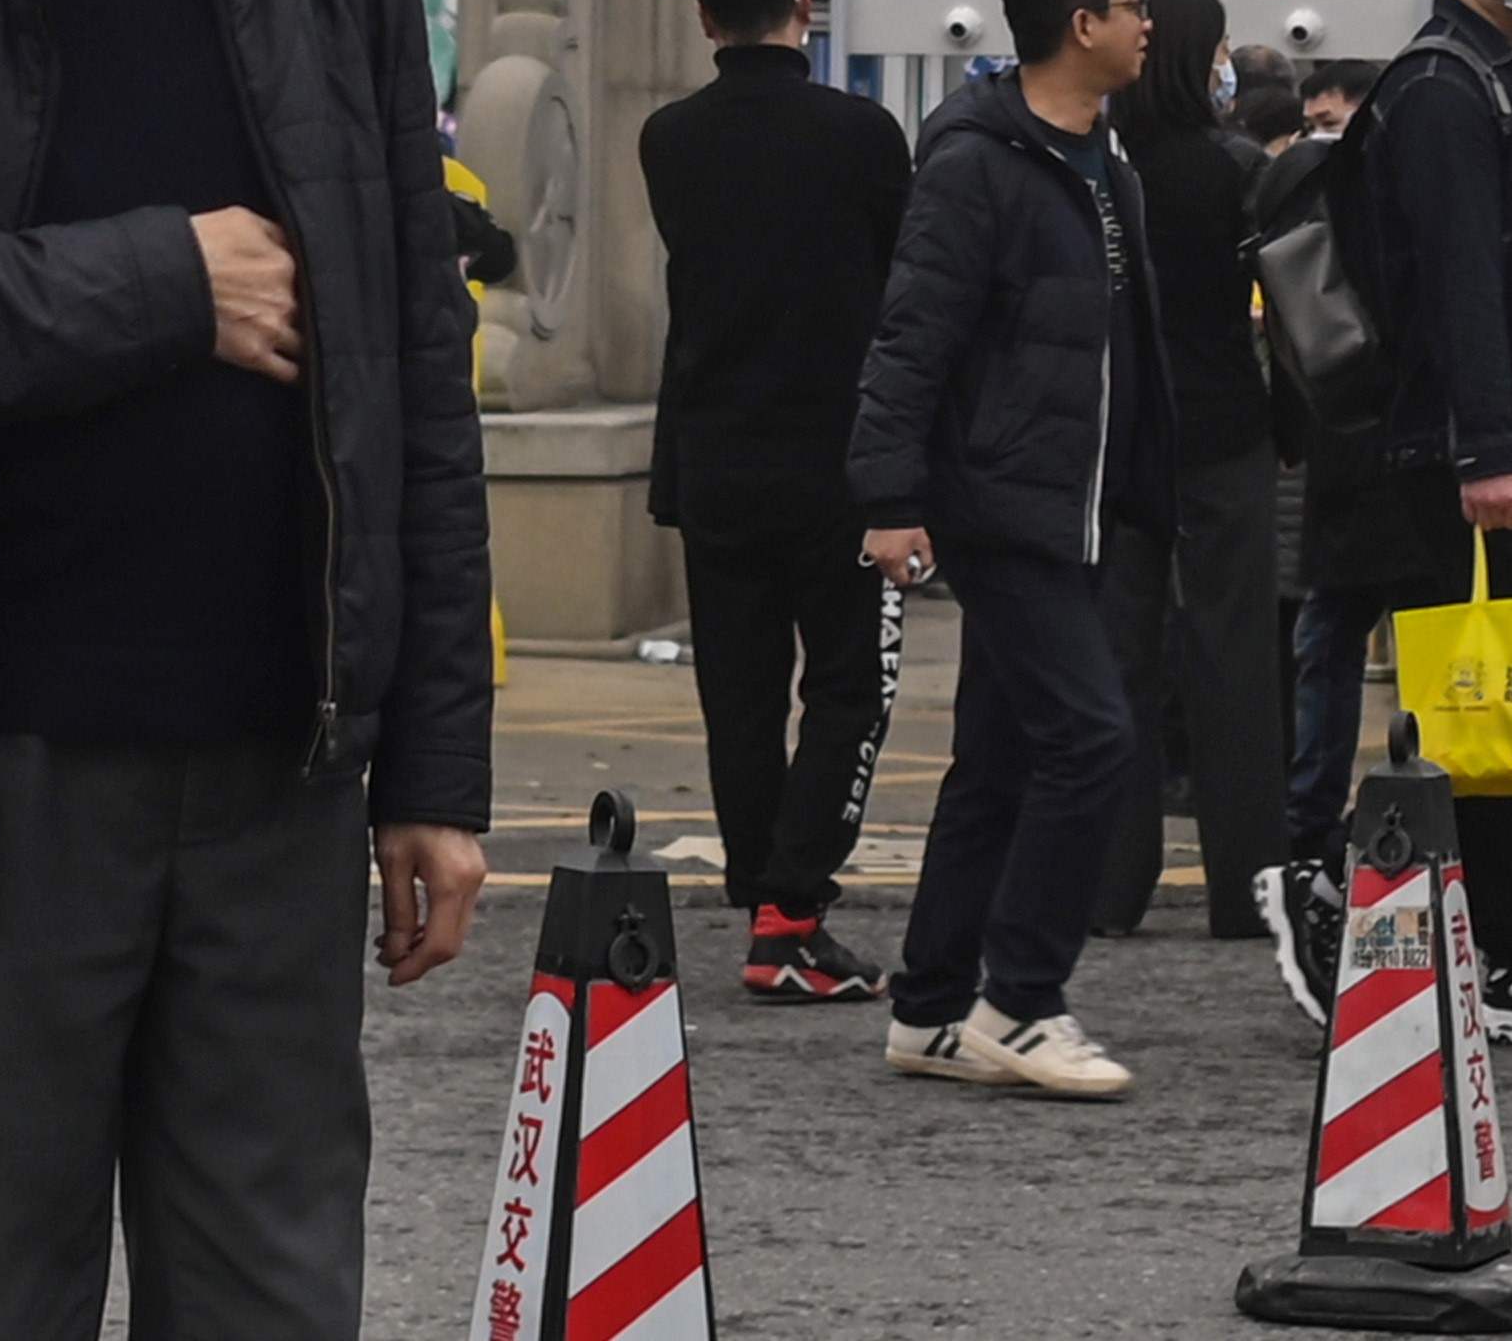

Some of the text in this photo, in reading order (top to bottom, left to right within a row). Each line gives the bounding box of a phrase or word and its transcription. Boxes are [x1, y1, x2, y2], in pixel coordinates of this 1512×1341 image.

[488, 1028, 556, 1341] 武汉交警
[1451, 910, 1496, 1181] 武汉交警
